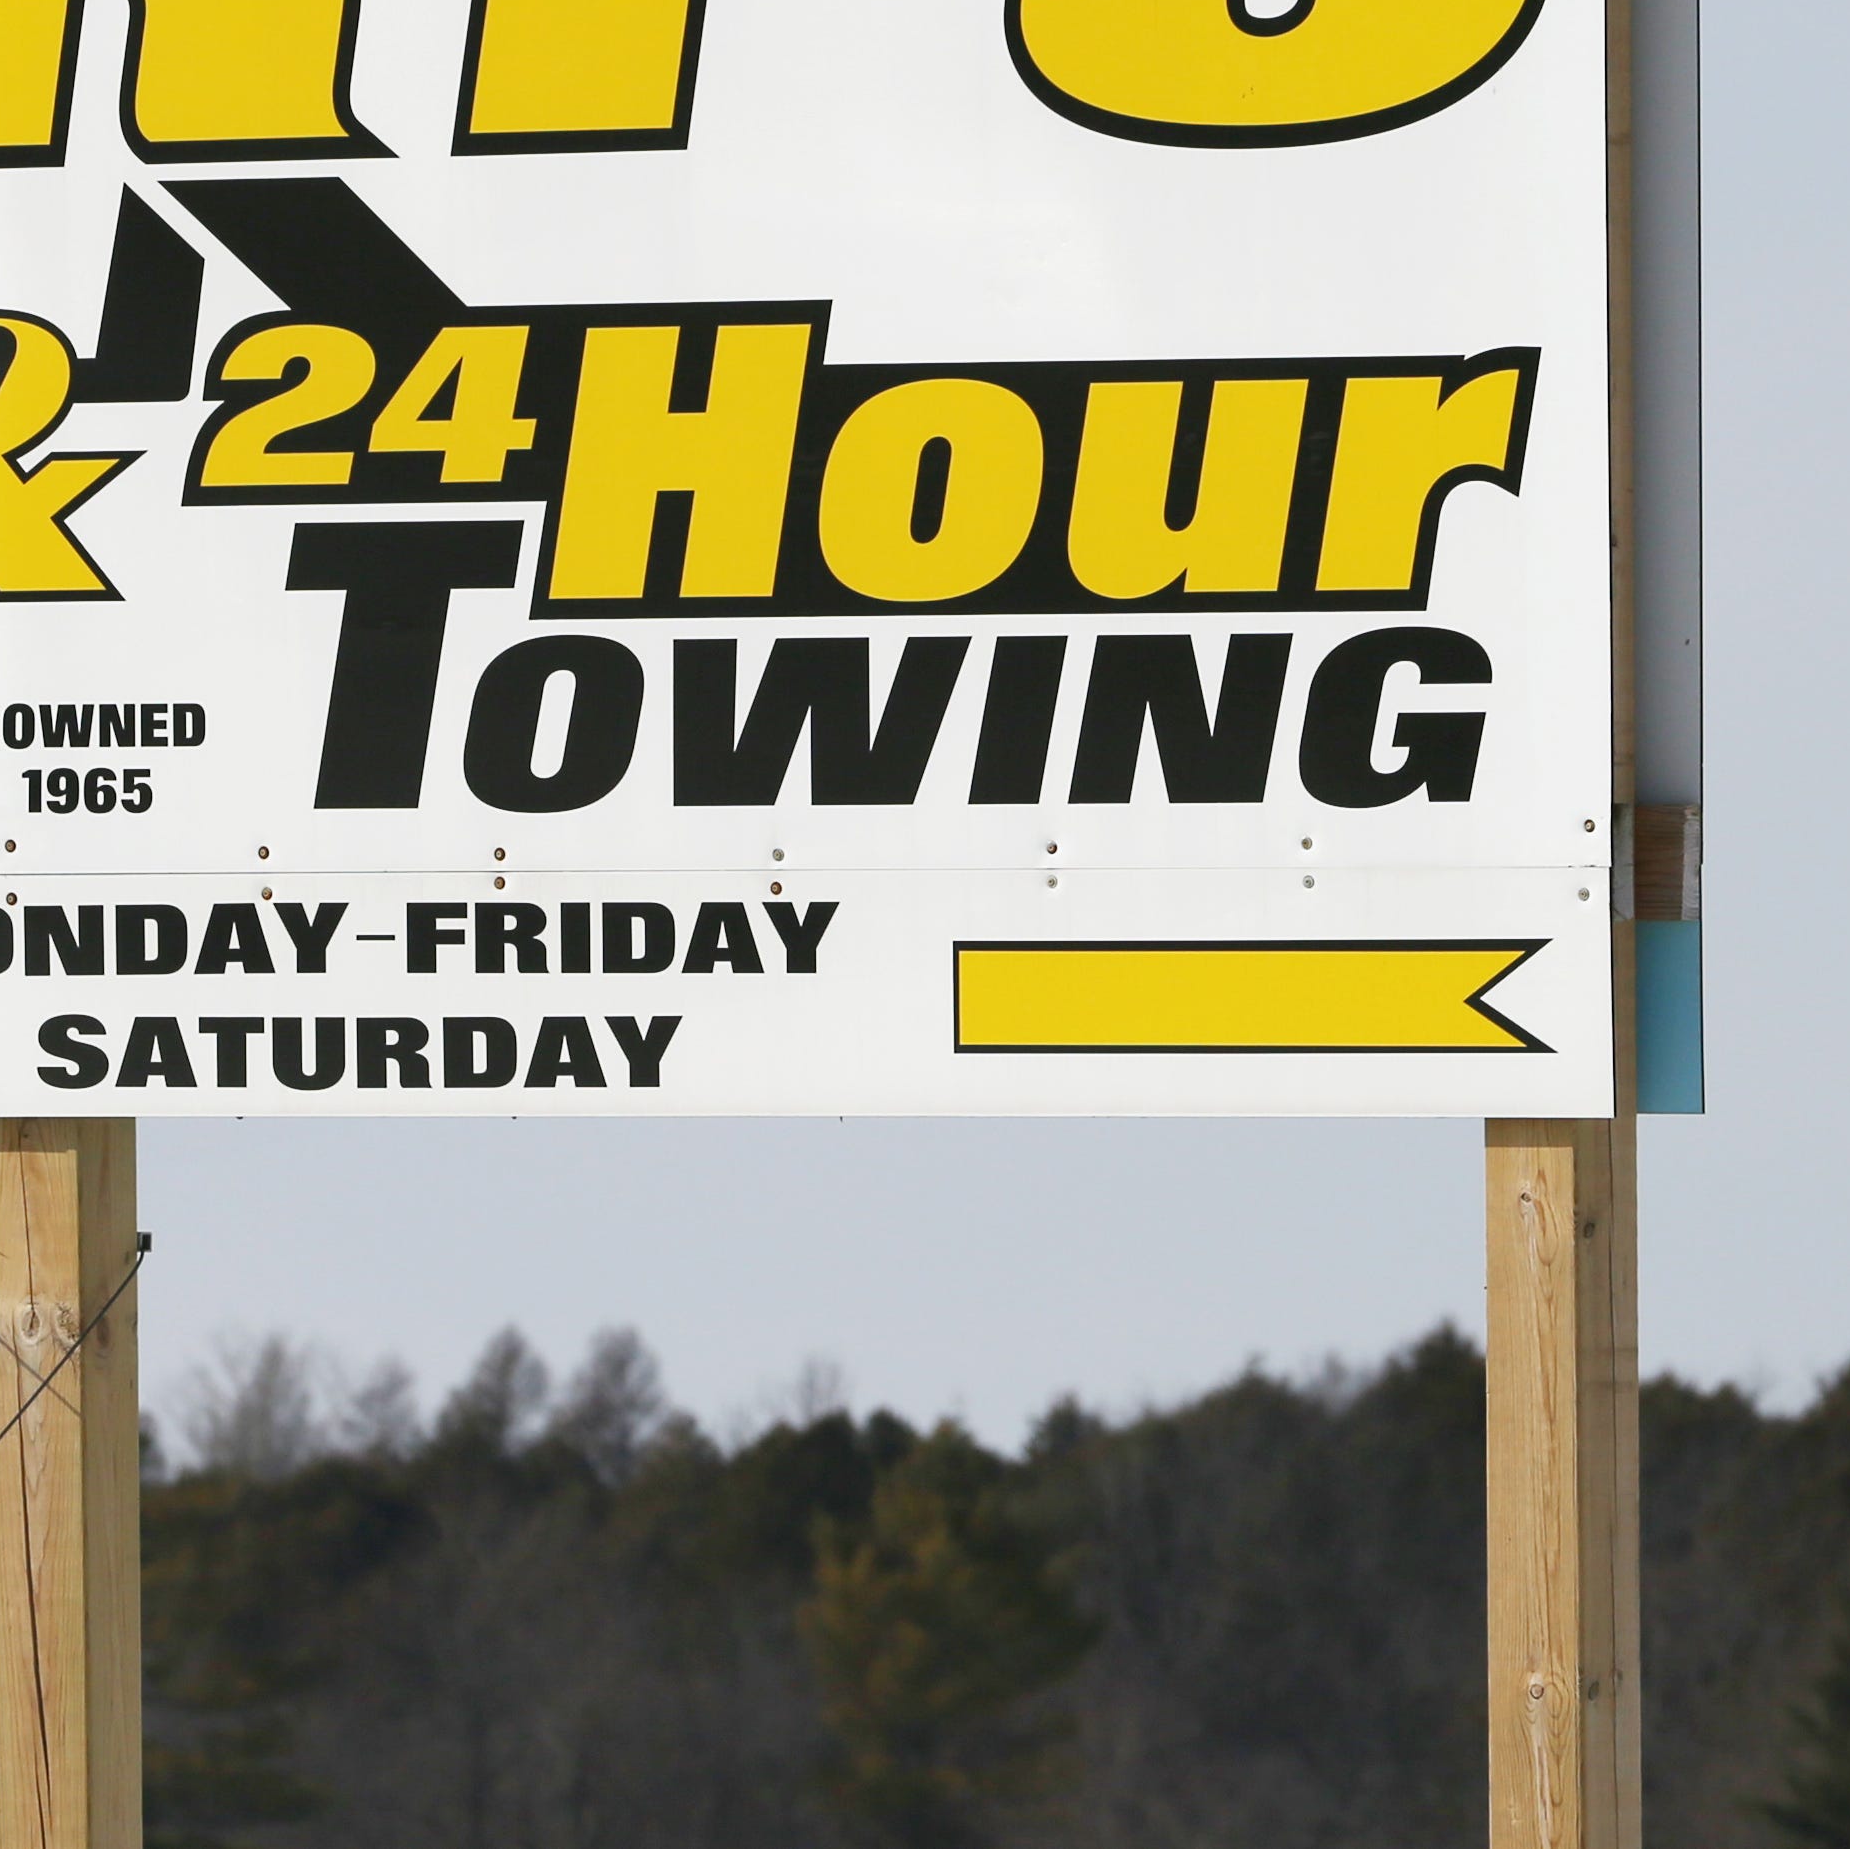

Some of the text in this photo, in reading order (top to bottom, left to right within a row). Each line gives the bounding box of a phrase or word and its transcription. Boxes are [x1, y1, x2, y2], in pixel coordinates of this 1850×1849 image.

[543, 316, 1531, 611] Hour
[284, 521, 1494, 811] TOWING
[1, 702, 208, 751] OWNED
[20, 766, 154, 815] 1965
[36, 1013, 684, 1092] SATURDAY
